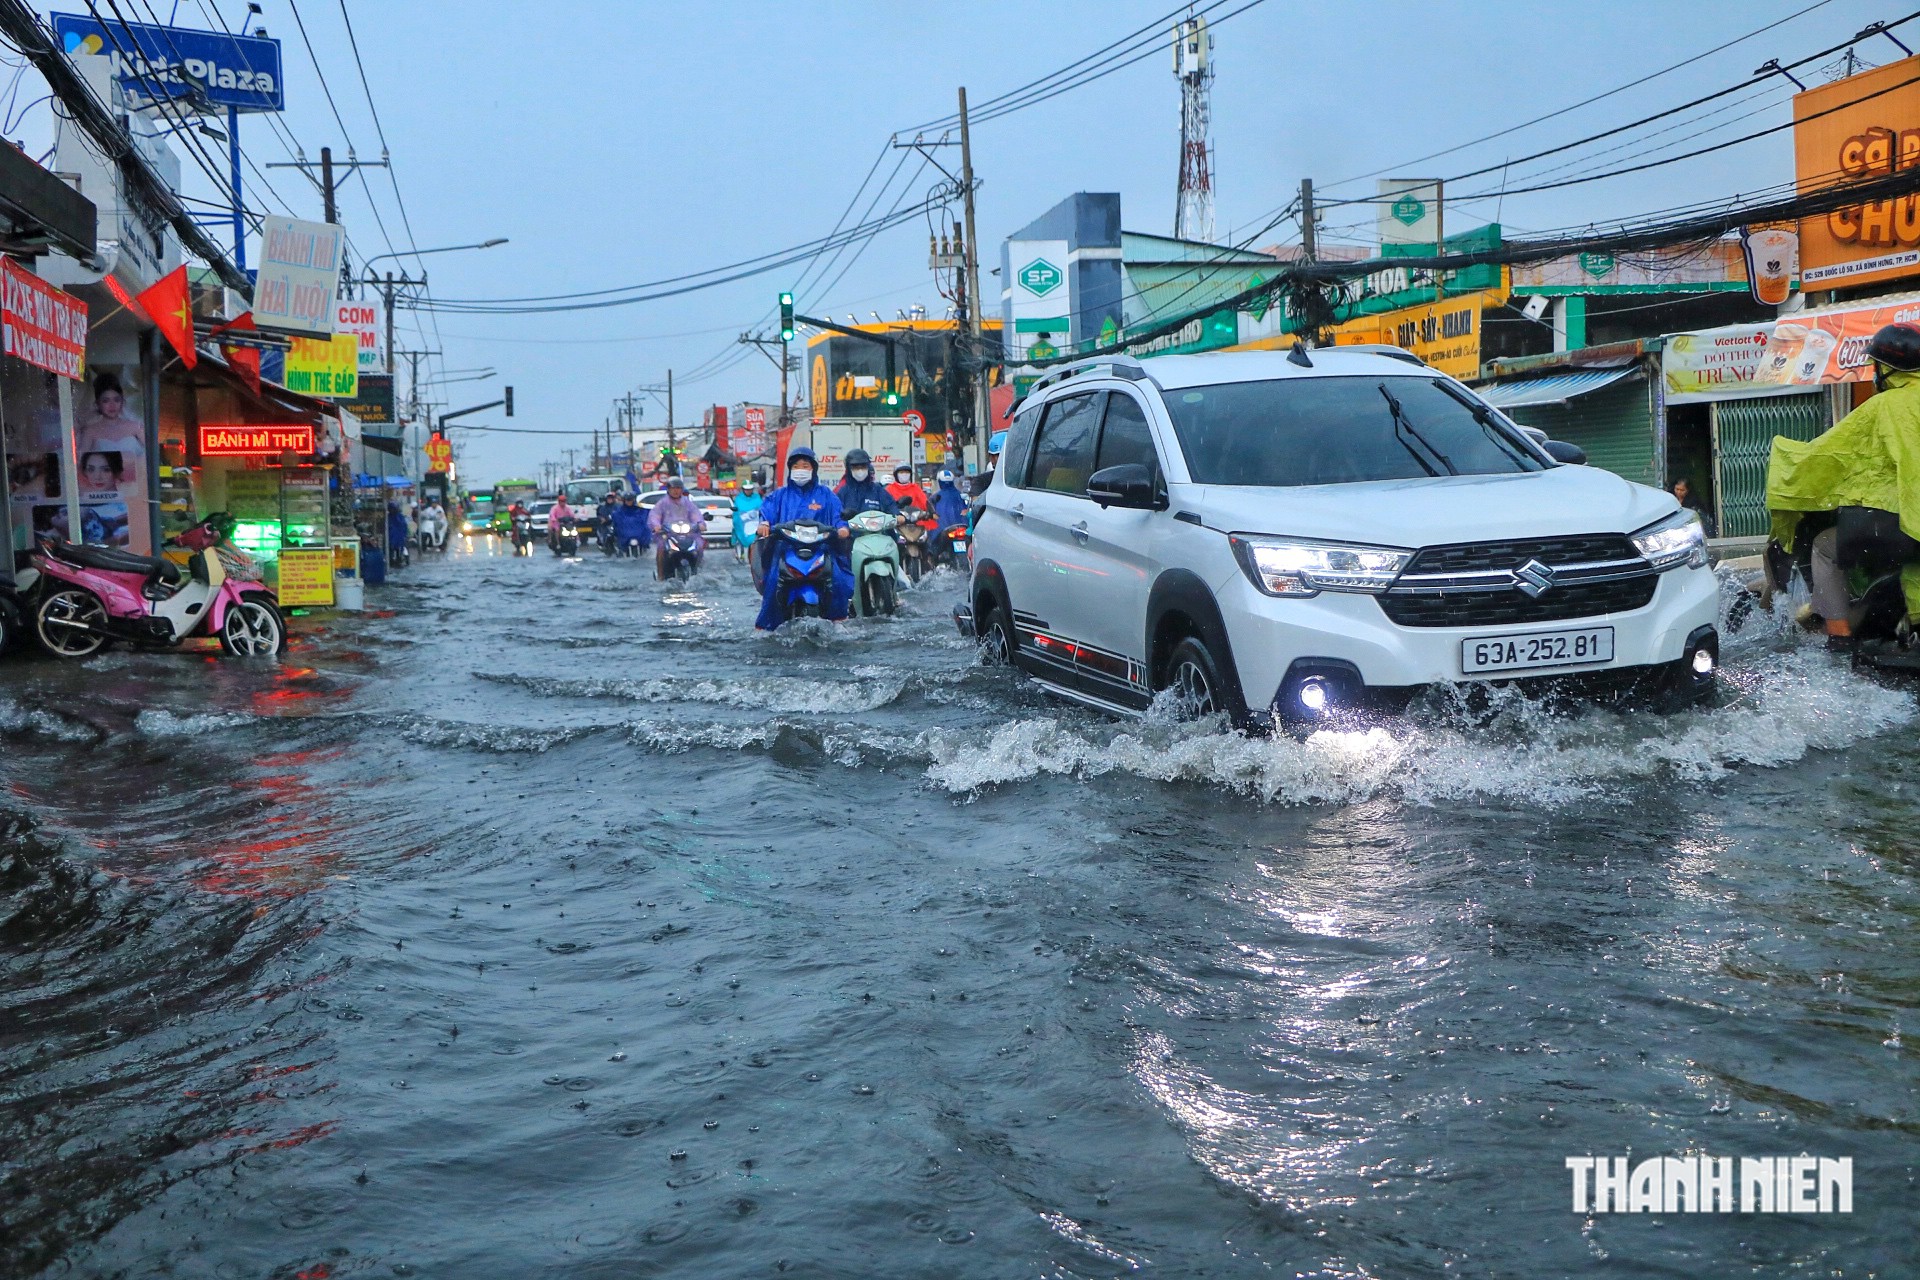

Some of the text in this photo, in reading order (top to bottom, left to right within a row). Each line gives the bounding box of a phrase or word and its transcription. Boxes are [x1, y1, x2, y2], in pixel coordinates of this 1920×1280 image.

[1904, 254, 1918, 262] HCM
[1028, 270, 1053, 281] SP
[1714, 335, 1752, 347] Vietlott
[207, 431, 307, 450] BÁNH MÌ THỊT
[1475, 634, 1598, 666] 63A-252.81
